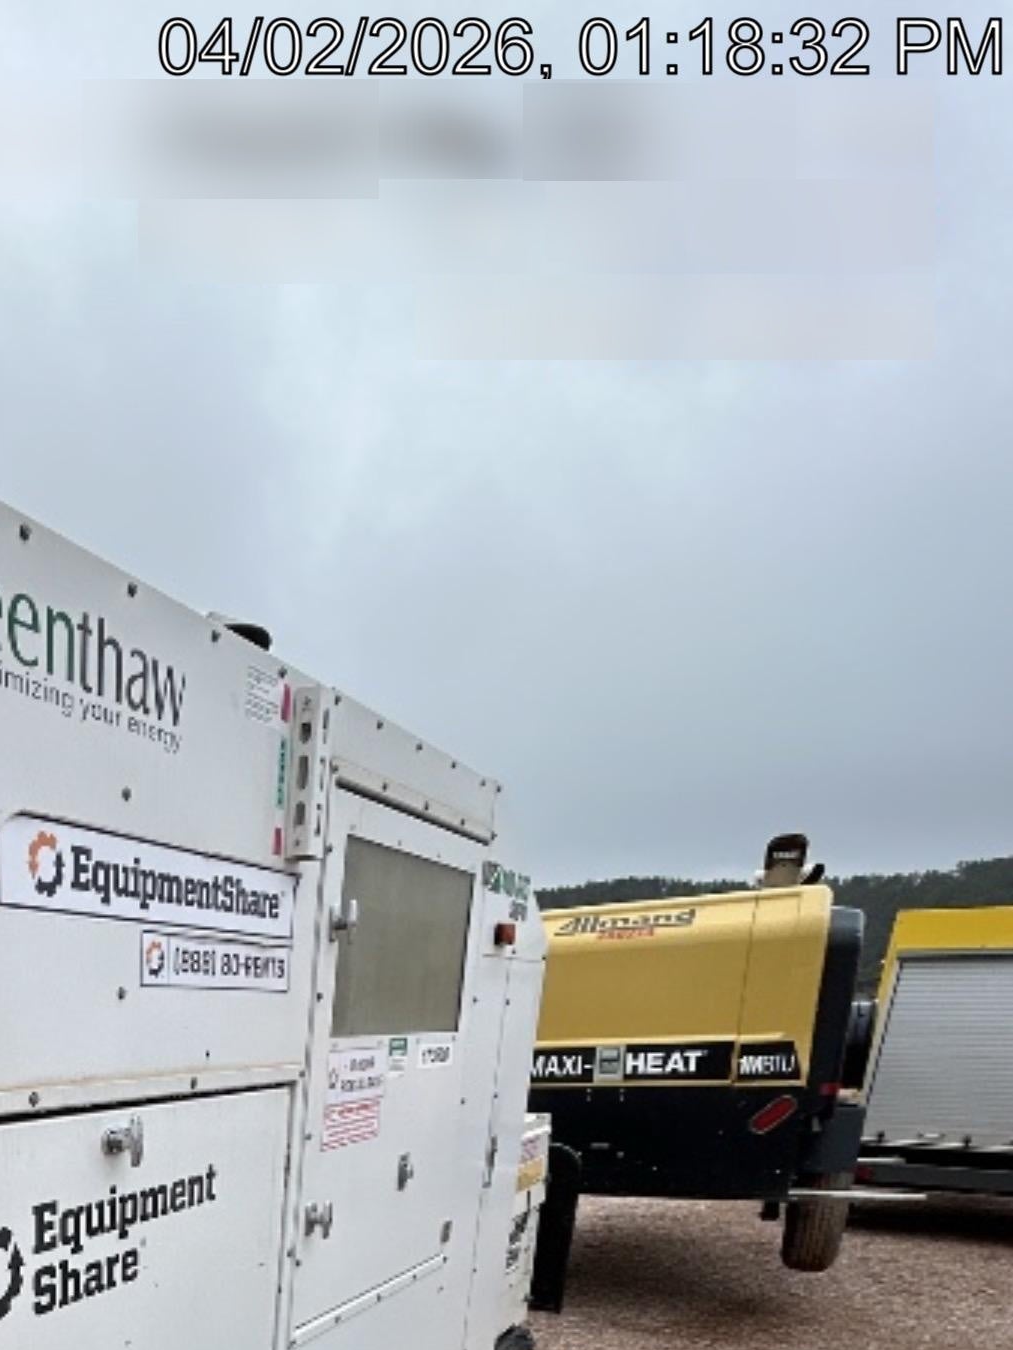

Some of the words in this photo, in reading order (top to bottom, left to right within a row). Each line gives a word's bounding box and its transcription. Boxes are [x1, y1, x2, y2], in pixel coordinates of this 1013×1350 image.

[78, 697, 123, 723] your
[127, 714, 183, 754] energy
[70, 845, 280, 920] EquipmentShare
[554, 908, 696, 936] Allmand
[626, 1050, 704, 1075] HEAT
[31, 1163, 218, 1254] Equipment
[33, 1247, 140, 1315] Share
